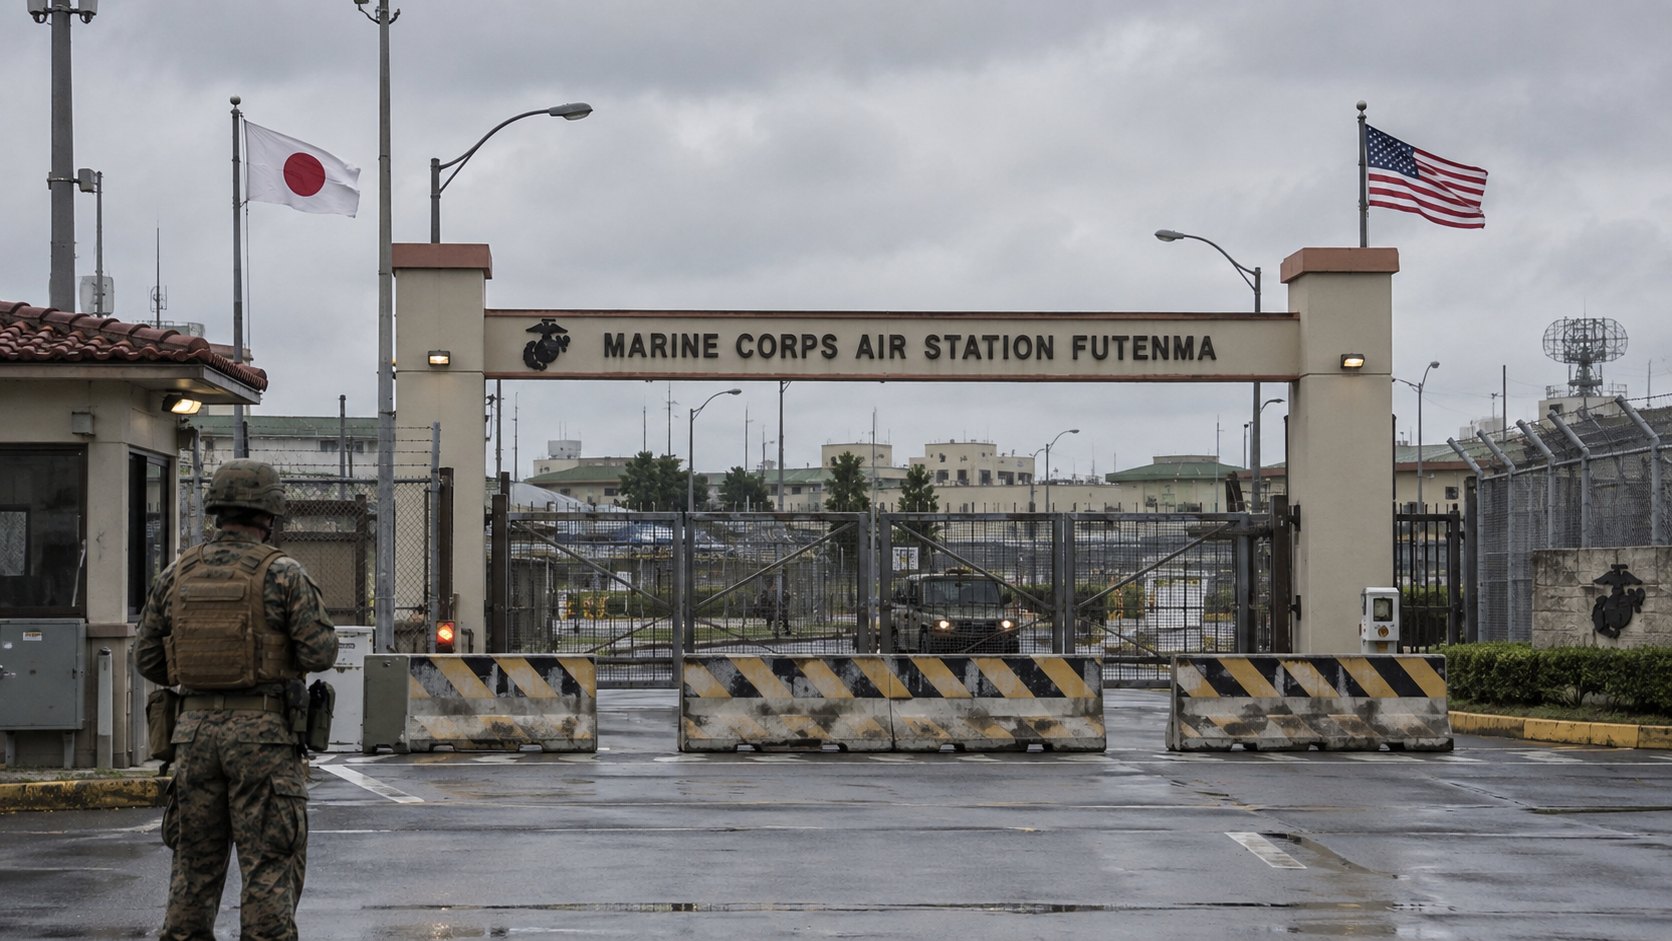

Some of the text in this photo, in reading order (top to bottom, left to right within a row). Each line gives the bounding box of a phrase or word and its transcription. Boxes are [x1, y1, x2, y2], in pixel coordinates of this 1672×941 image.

[604, 333, 1217, 361] MARINE CORPS AIR STATION FUTENMA
